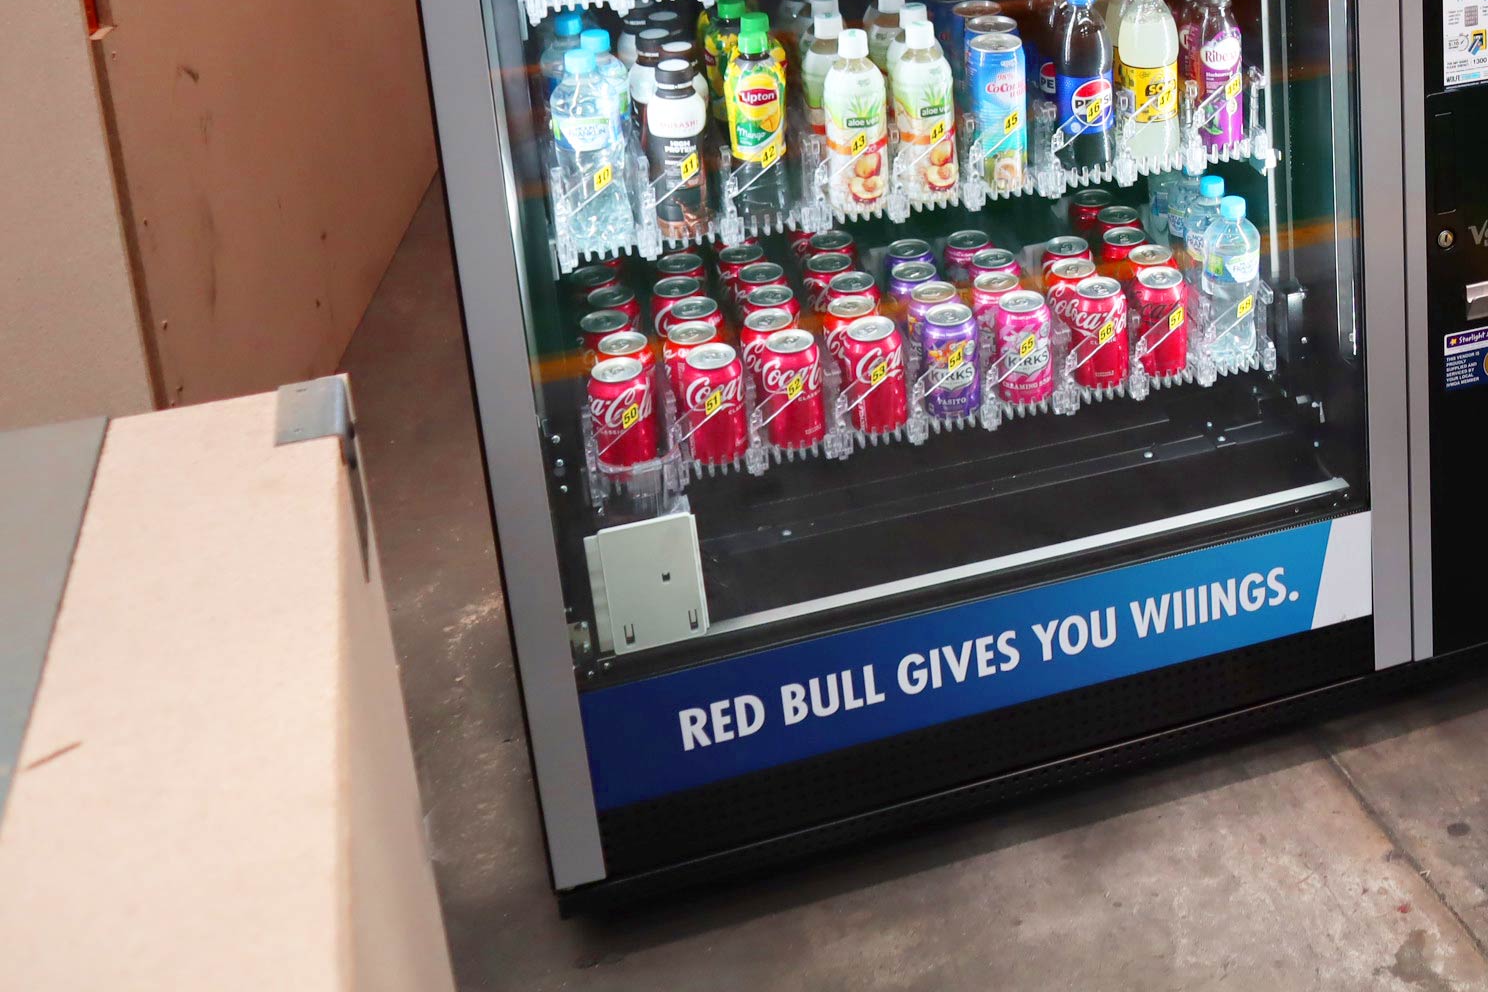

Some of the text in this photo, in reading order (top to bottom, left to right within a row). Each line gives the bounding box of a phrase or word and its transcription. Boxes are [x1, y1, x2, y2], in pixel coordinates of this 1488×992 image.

[1473, 56, 1487, 64] 1300
[740, 89, 777, 106] Lipton
[921, 107, 940, 117] aloe
[847, 118, 865, 127] aloe
[1004, 114, 1018, 130] 45
[736, 125, 766, 139] Mango
[931, 124, 944, 139] 44
[664, 144, 697, 154] PROTEIN
[669, 139, 691, 147] HIGH
[852, 136, 865, 151] 43
[762, 146, 776, 161] 42
[682, 159, 695, 174] 41
[1170, 313, 1182, 327] 57
[1100, 326, 1112, 339] 56
[1459, 331, 1485, 343] Starlight
[1020, 340, 1034, 355] 55
[949, 353, 962, 368] 54
[1008, 351, 1048, 369] KIRKS
[872, 365, 886, 381] 53
[930, 363, 973, 381] KIRKS
[788, 380, 802, 396] 52
[706, 395, 719, 410] 51
[937, 395, 967, 405] PASITO
[623, 410, 637, 425] 50
[678, 565, 1301, 752] RED BULL GIVES YOU WIIINGS.
